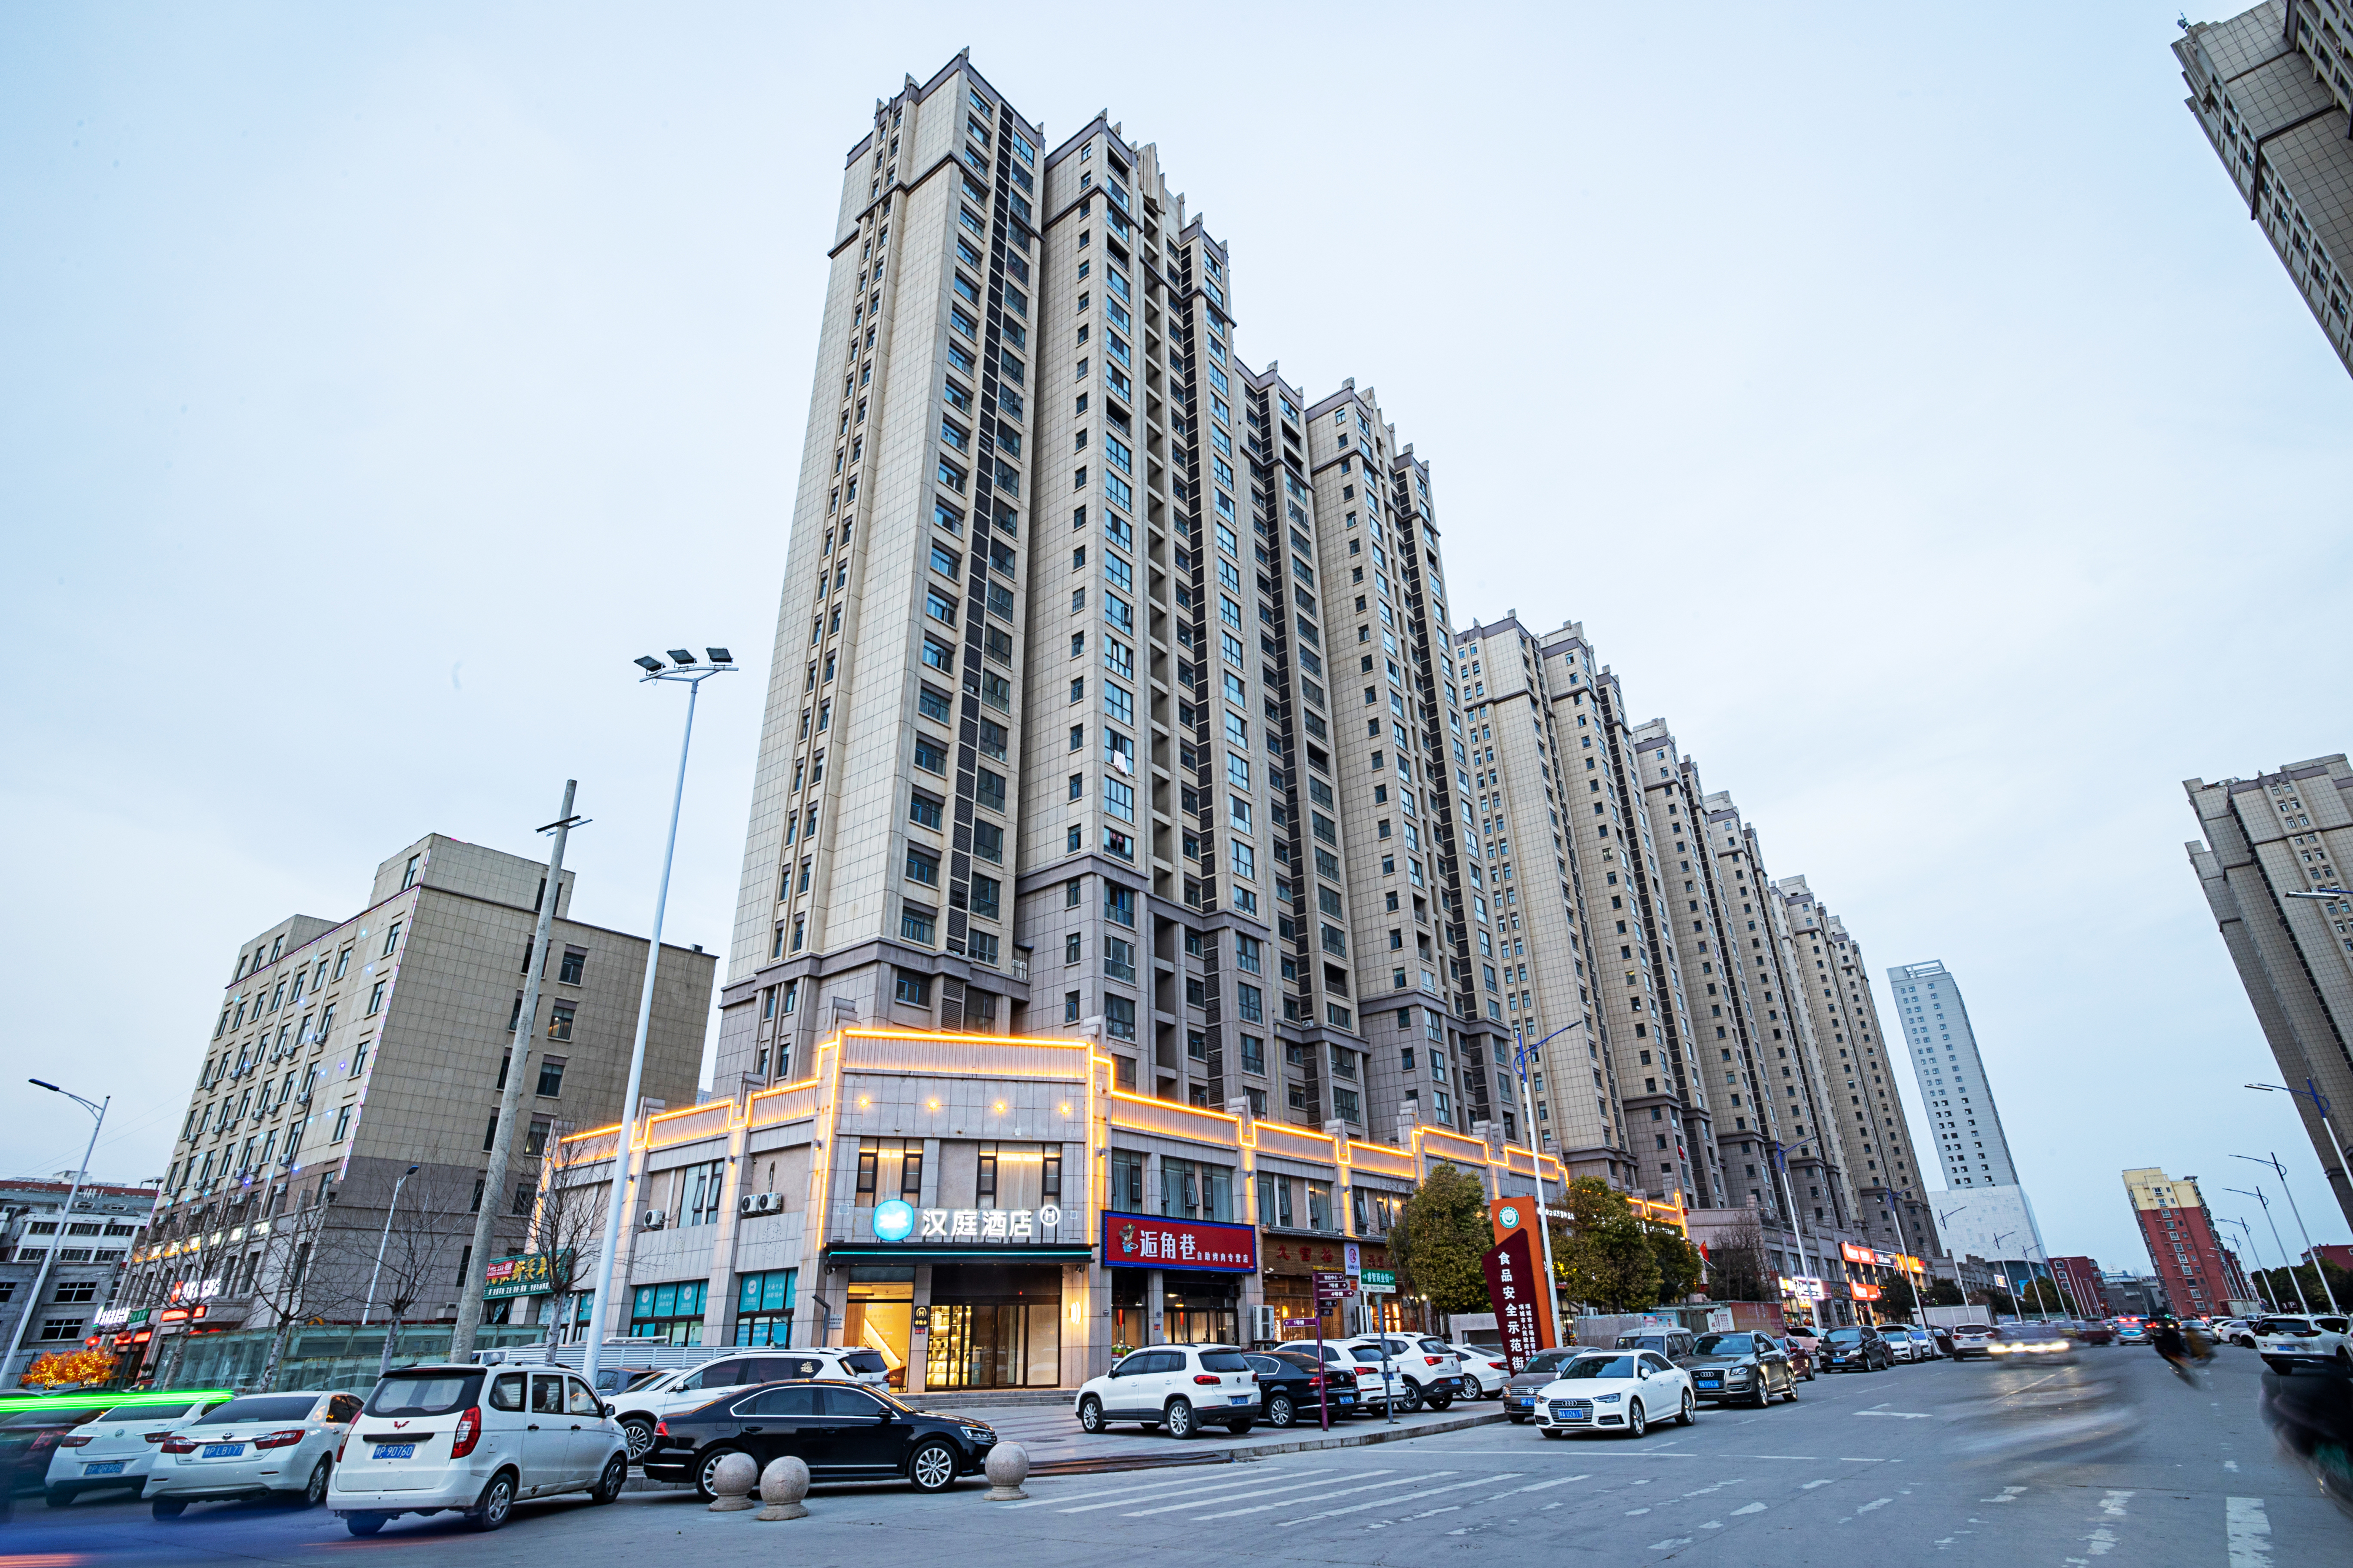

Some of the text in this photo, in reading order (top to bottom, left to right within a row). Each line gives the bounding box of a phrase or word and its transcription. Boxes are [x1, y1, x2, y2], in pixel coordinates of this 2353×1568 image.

[922, 1210, 1032, 1236] 汉庭酒店
[1139, 1230, 1196, 1260] 逅角巷
[1197, 1251, 1249, 1264] 自助烤肉专营店
[1367, 1272, 1389, 1283] 睿智商业街
[1498, 1252, 1524, 1370] 食品安全示范街
